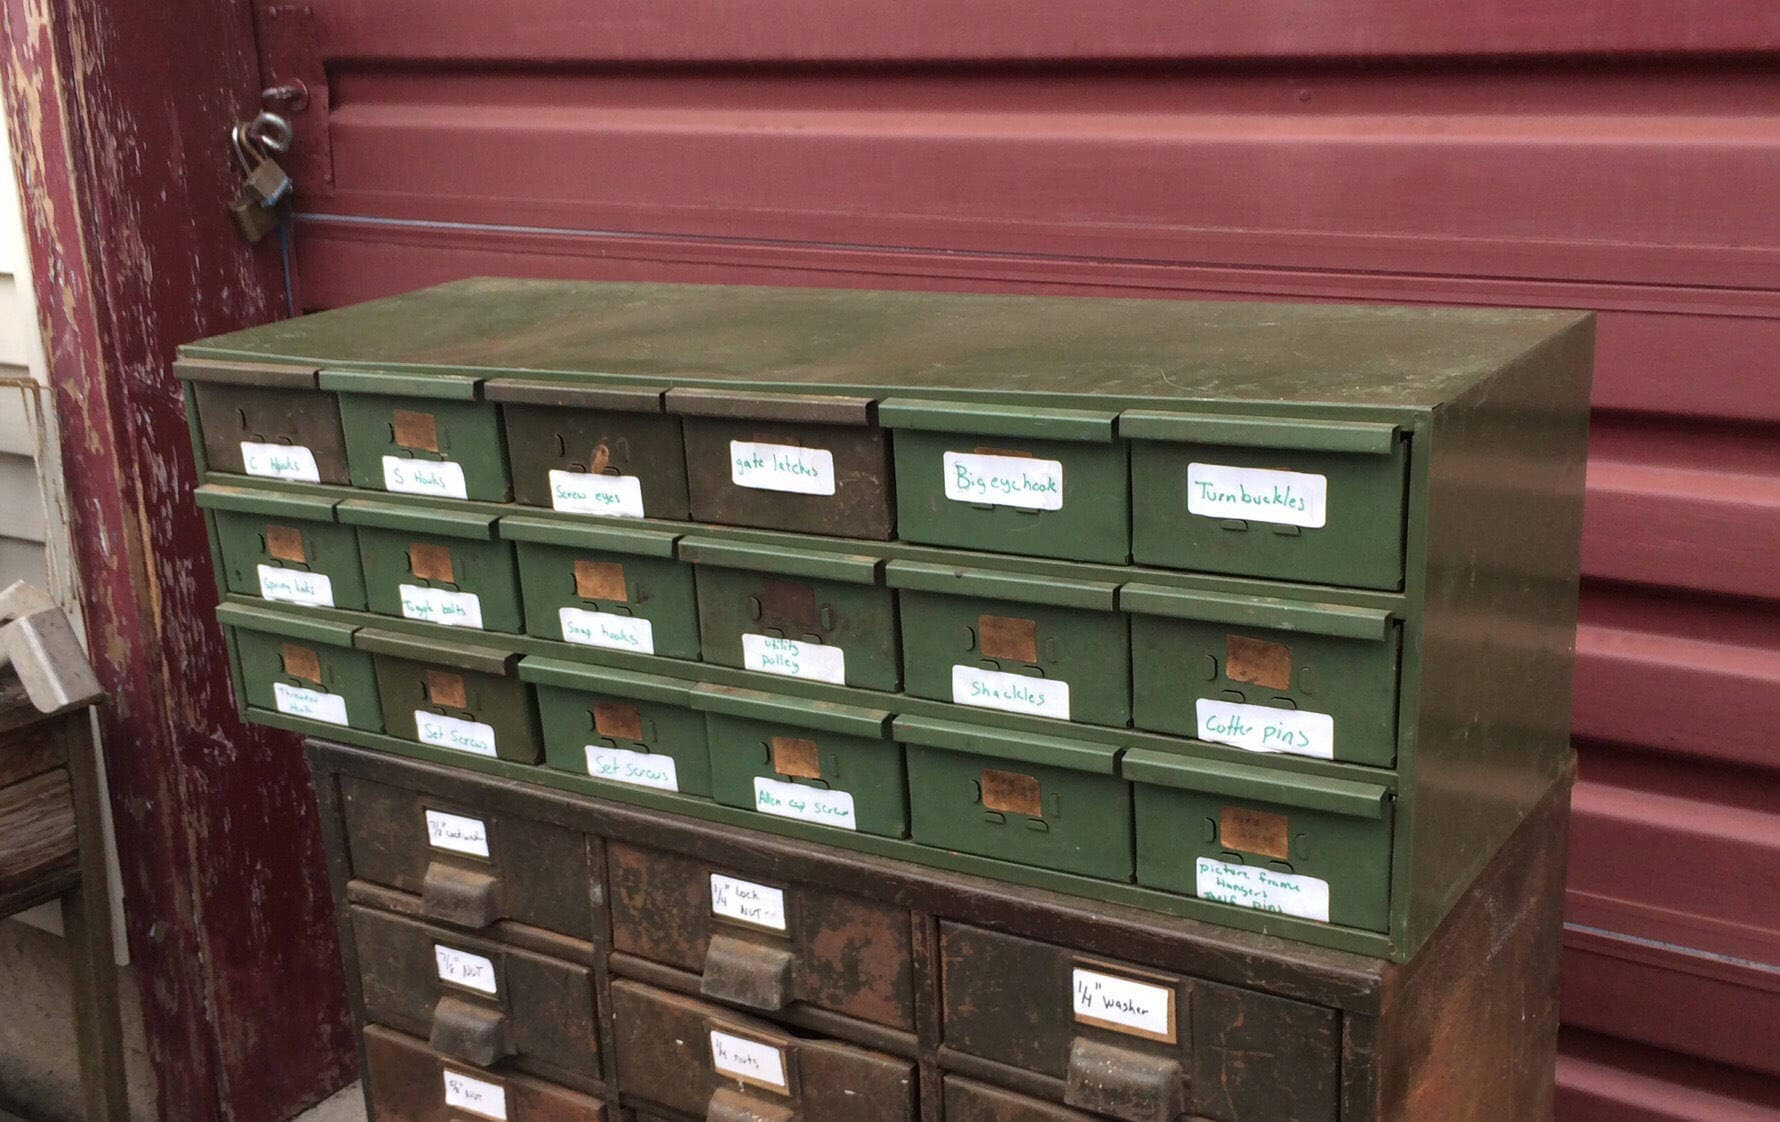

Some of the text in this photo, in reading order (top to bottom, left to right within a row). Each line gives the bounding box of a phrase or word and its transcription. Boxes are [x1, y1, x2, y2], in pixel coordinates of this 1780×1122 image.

[736, 452, 764, 475] gate
[954, 462, 986, 494] Big
[556, 484, 587, 500] Screw
[1194, 480, 1305, 511] Turnbuckles
[971, 681, 1046, 706] Shackles
[1262, 721, 1310, 748] pins
